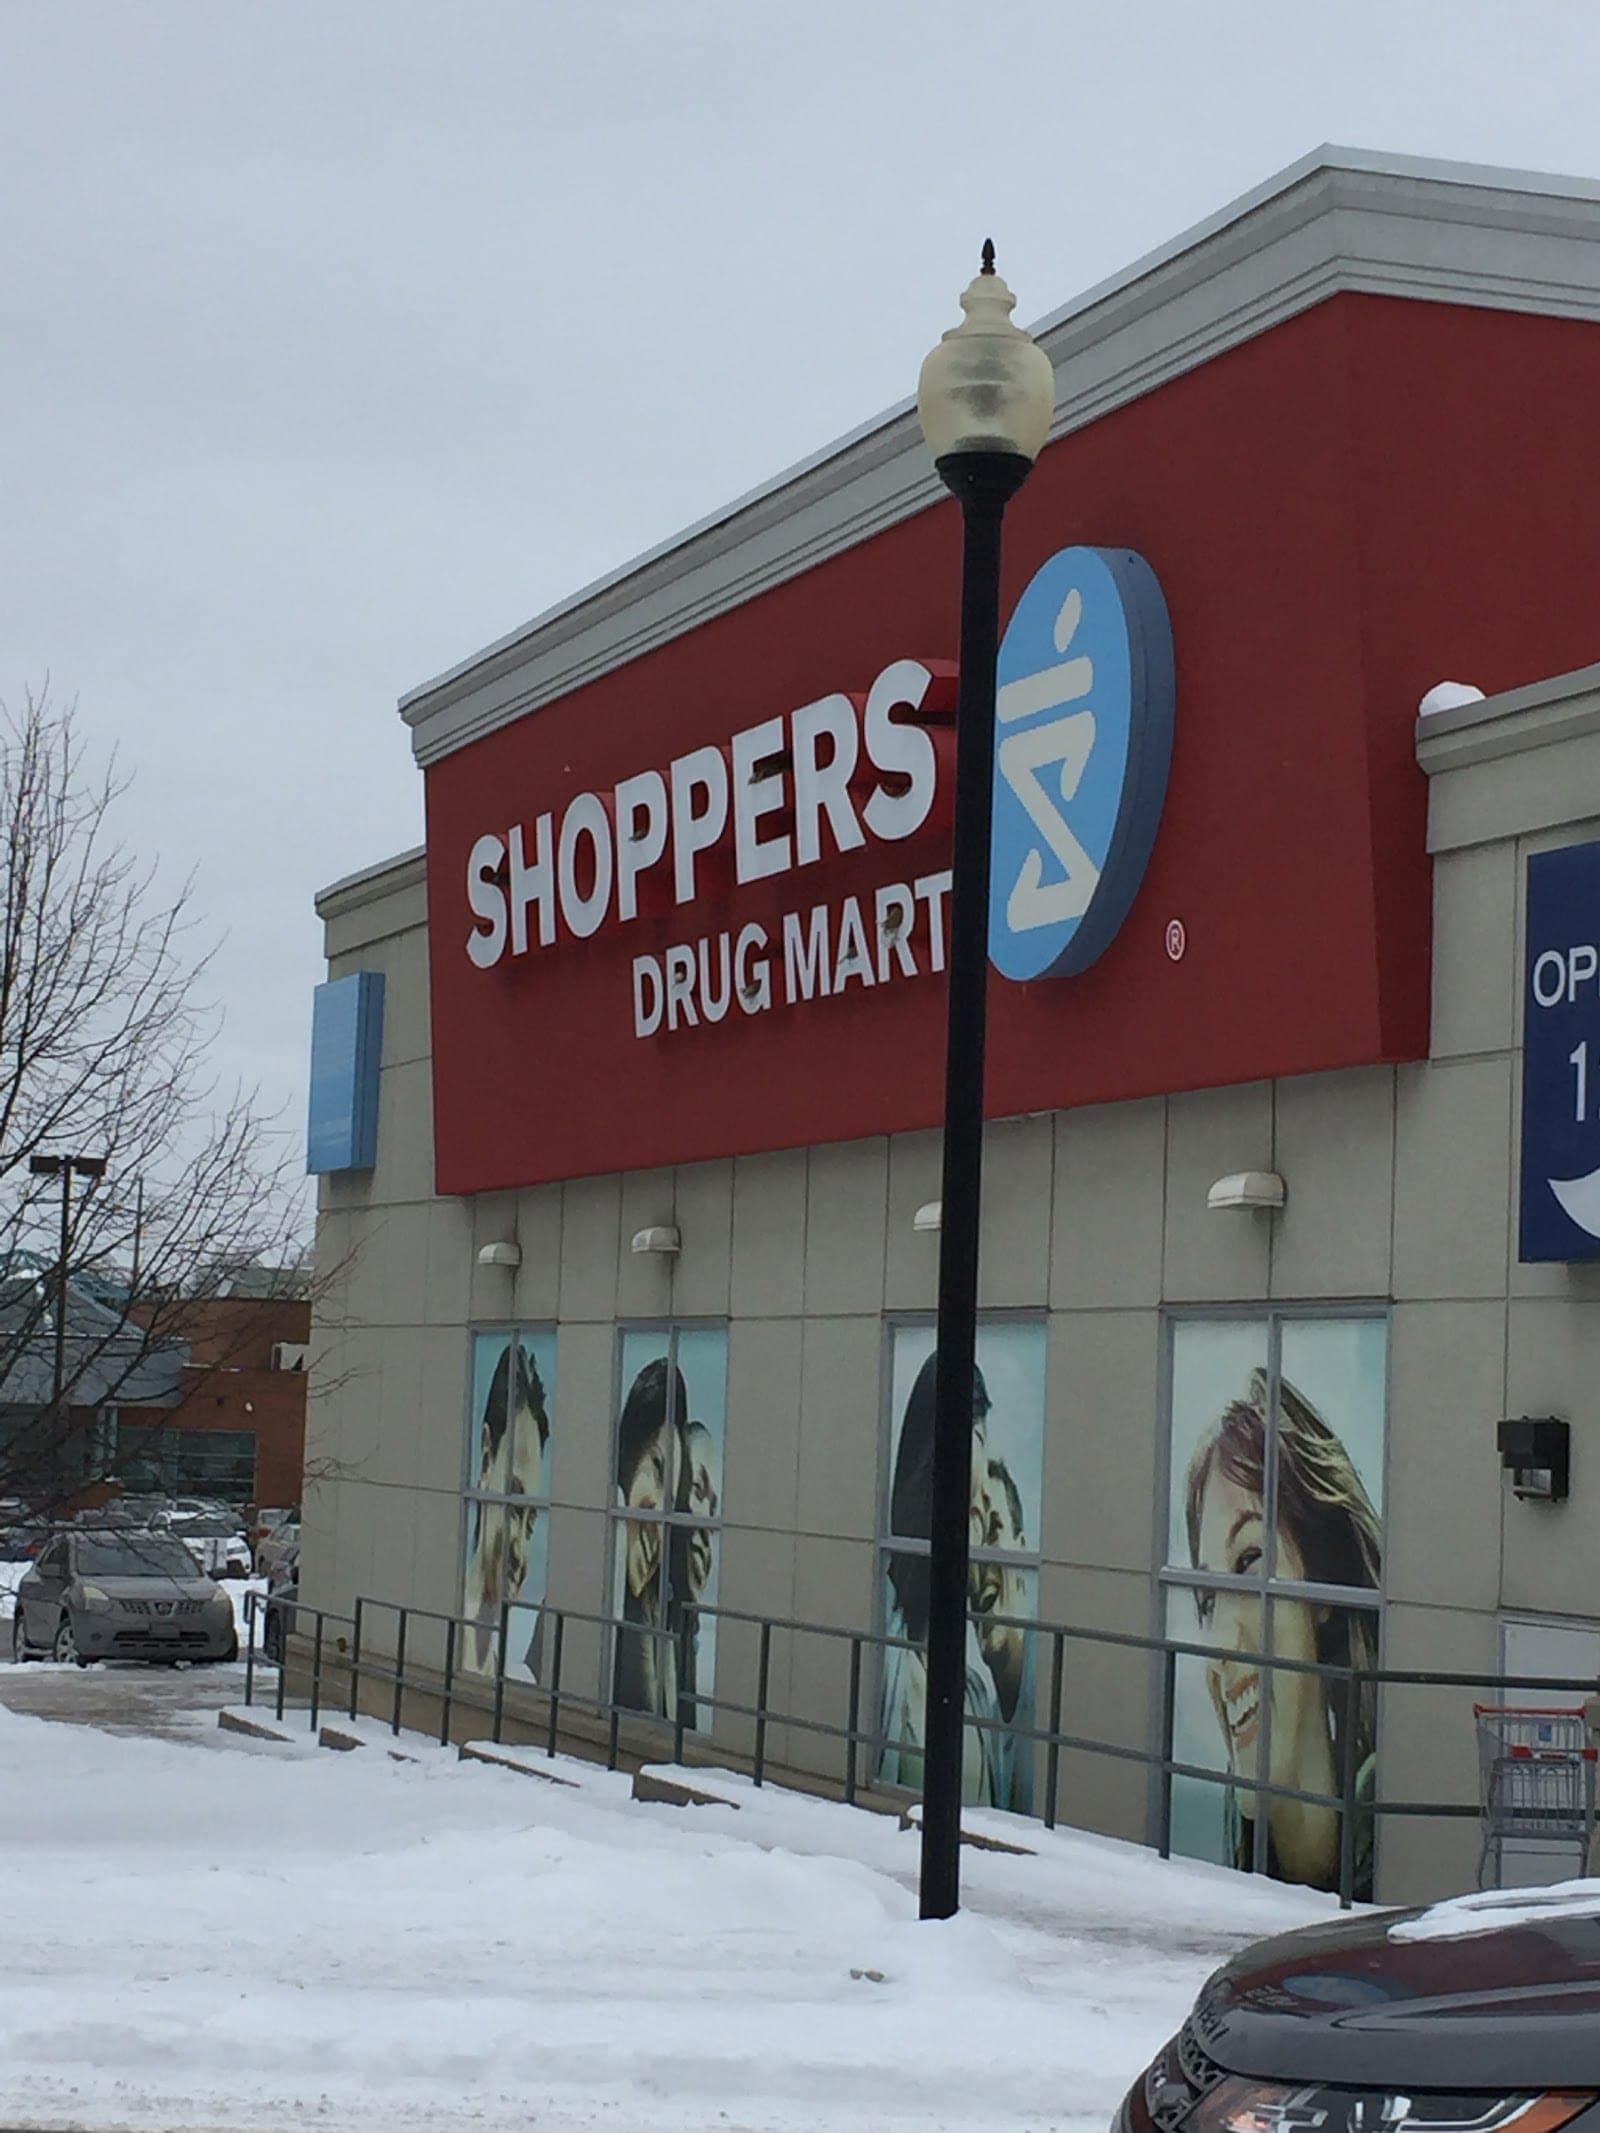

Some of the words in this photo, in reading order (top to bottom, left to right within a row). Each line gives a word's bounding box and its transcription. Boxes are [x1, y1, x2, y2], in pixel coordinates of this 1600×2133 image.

[466, 659, 936, 969] SHOPPERS
[632, 922, 771, 1039] DRUG
[782, 870, 953, 1004] MART
[1533, 945, 1600, 1008] OP
[1569, 1041, 1600, 1122] 1
